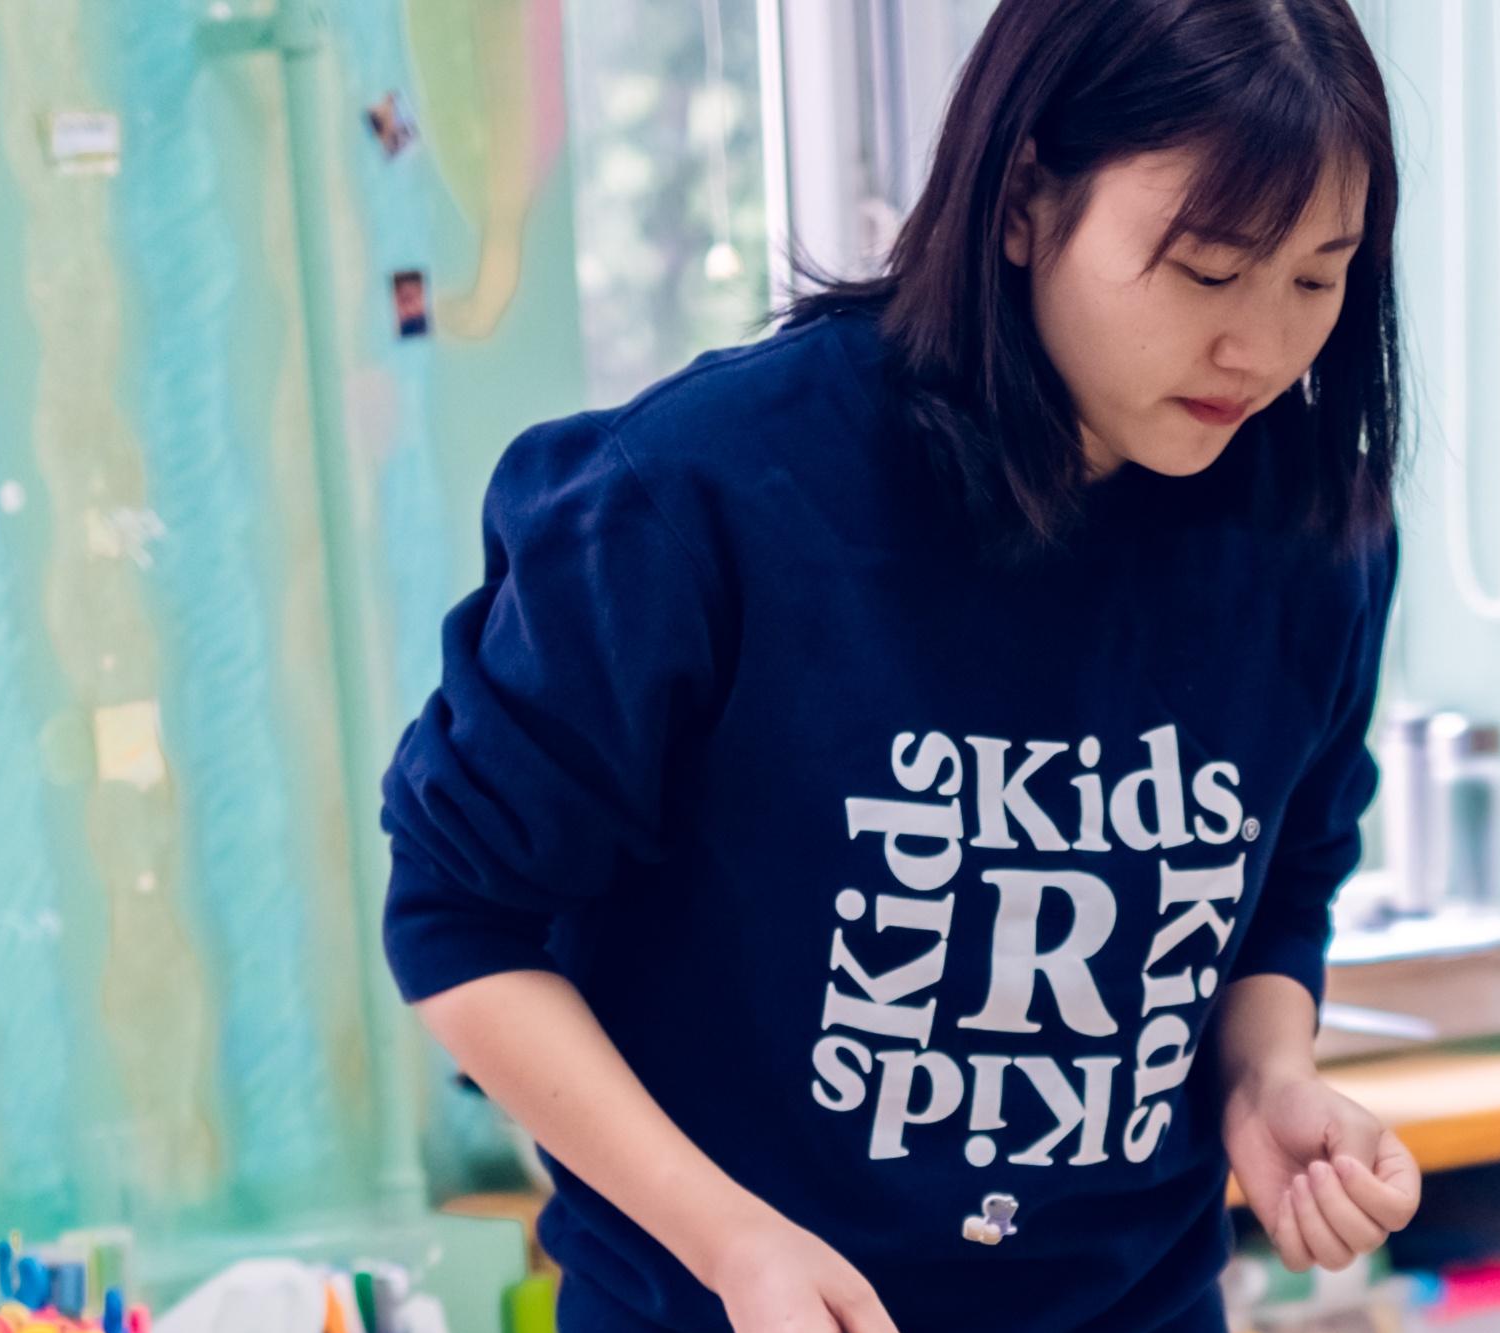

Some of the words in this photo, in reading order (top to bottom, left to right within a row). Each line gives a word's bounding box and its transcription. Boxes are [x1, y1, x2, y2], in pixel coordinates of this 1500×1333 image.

[964, 724, 1244, 852] Kids
[821, 731, 964, 1049] Kids
[957, 869, 1118, 1037] R
[1123, 852, 1246, 1164] Kids
[811, 1035, 1122, 1168] Kids
